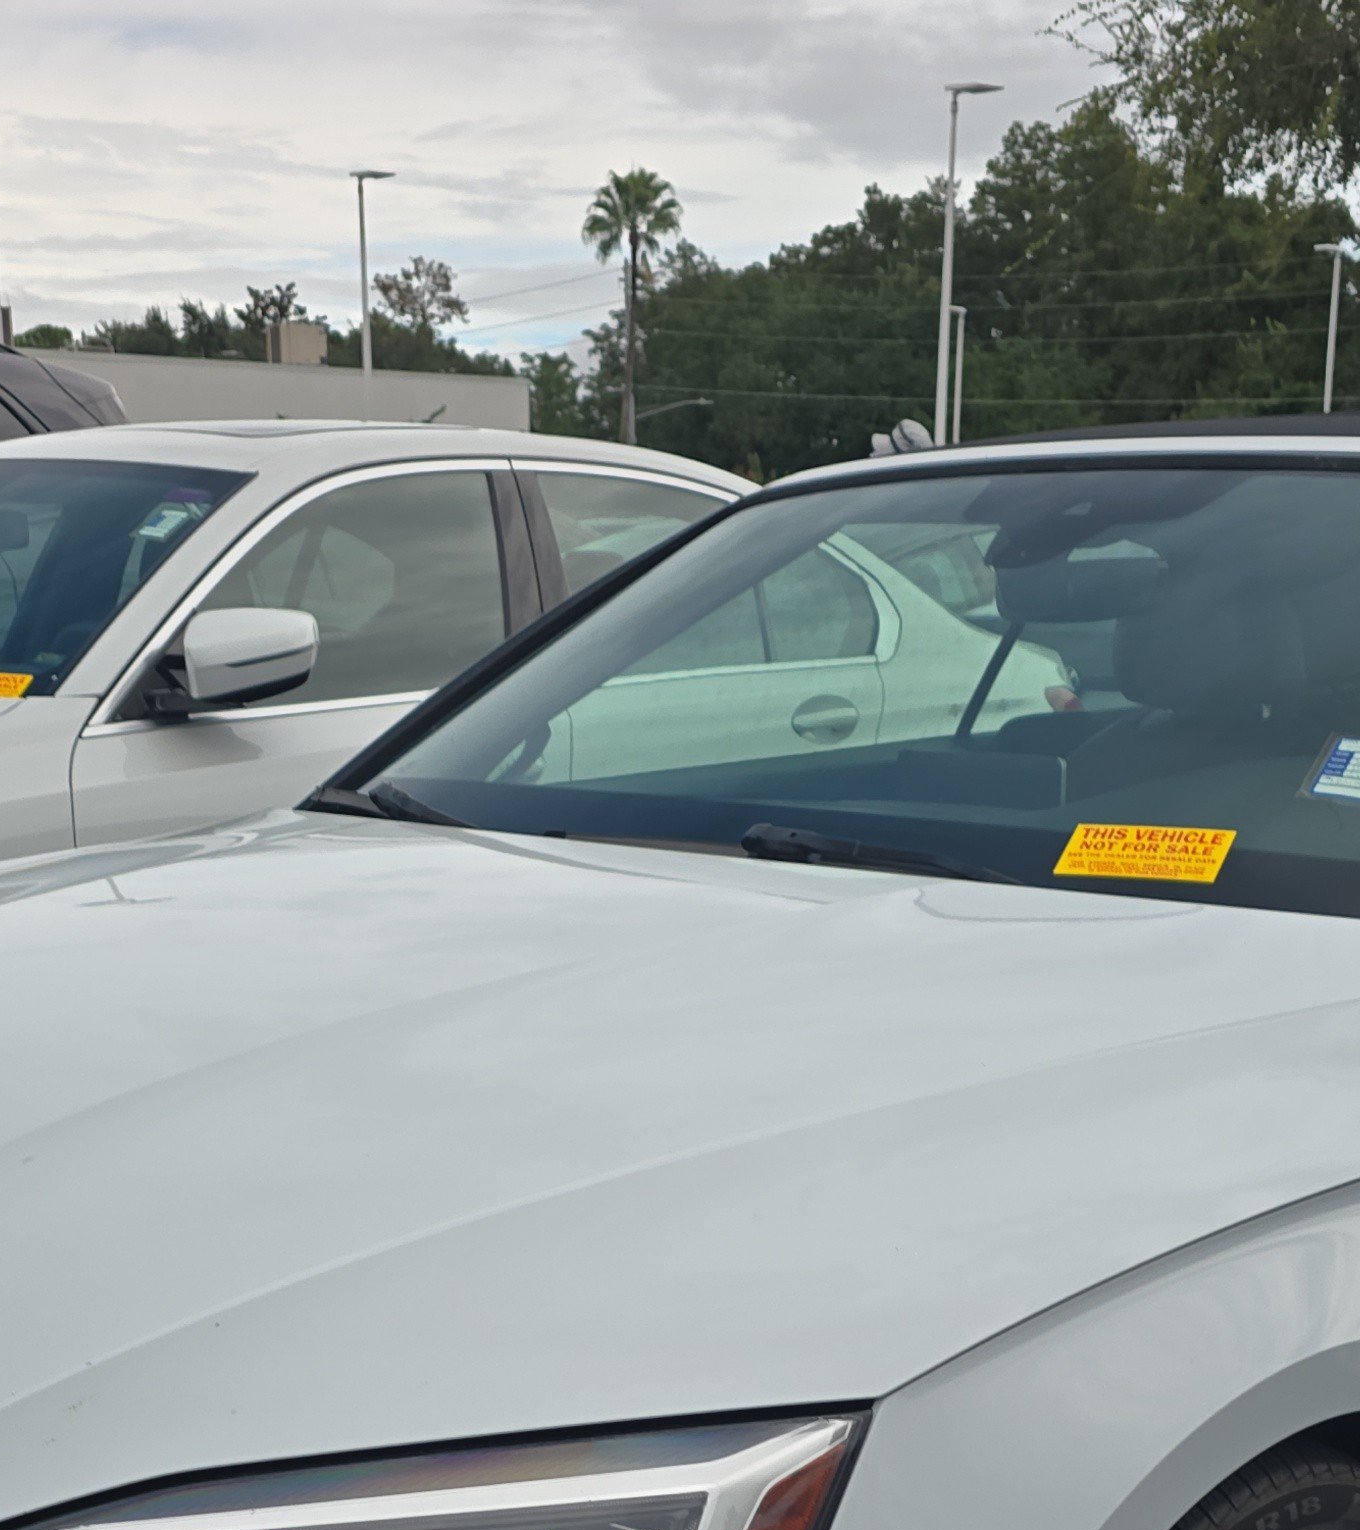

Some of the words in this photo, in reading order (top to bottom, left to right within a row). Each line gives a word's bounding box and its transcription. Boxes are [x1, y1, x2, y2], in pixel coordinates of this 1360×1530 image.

[1082, 827, 1128, 841] THIS
[1135, 829, 1227, 846] VEHICLE
[1080, 841, 1114, 852] NOT
[1122, 842, 1160, 853] FOR
[1165, 844, 1216, 857] SALE
